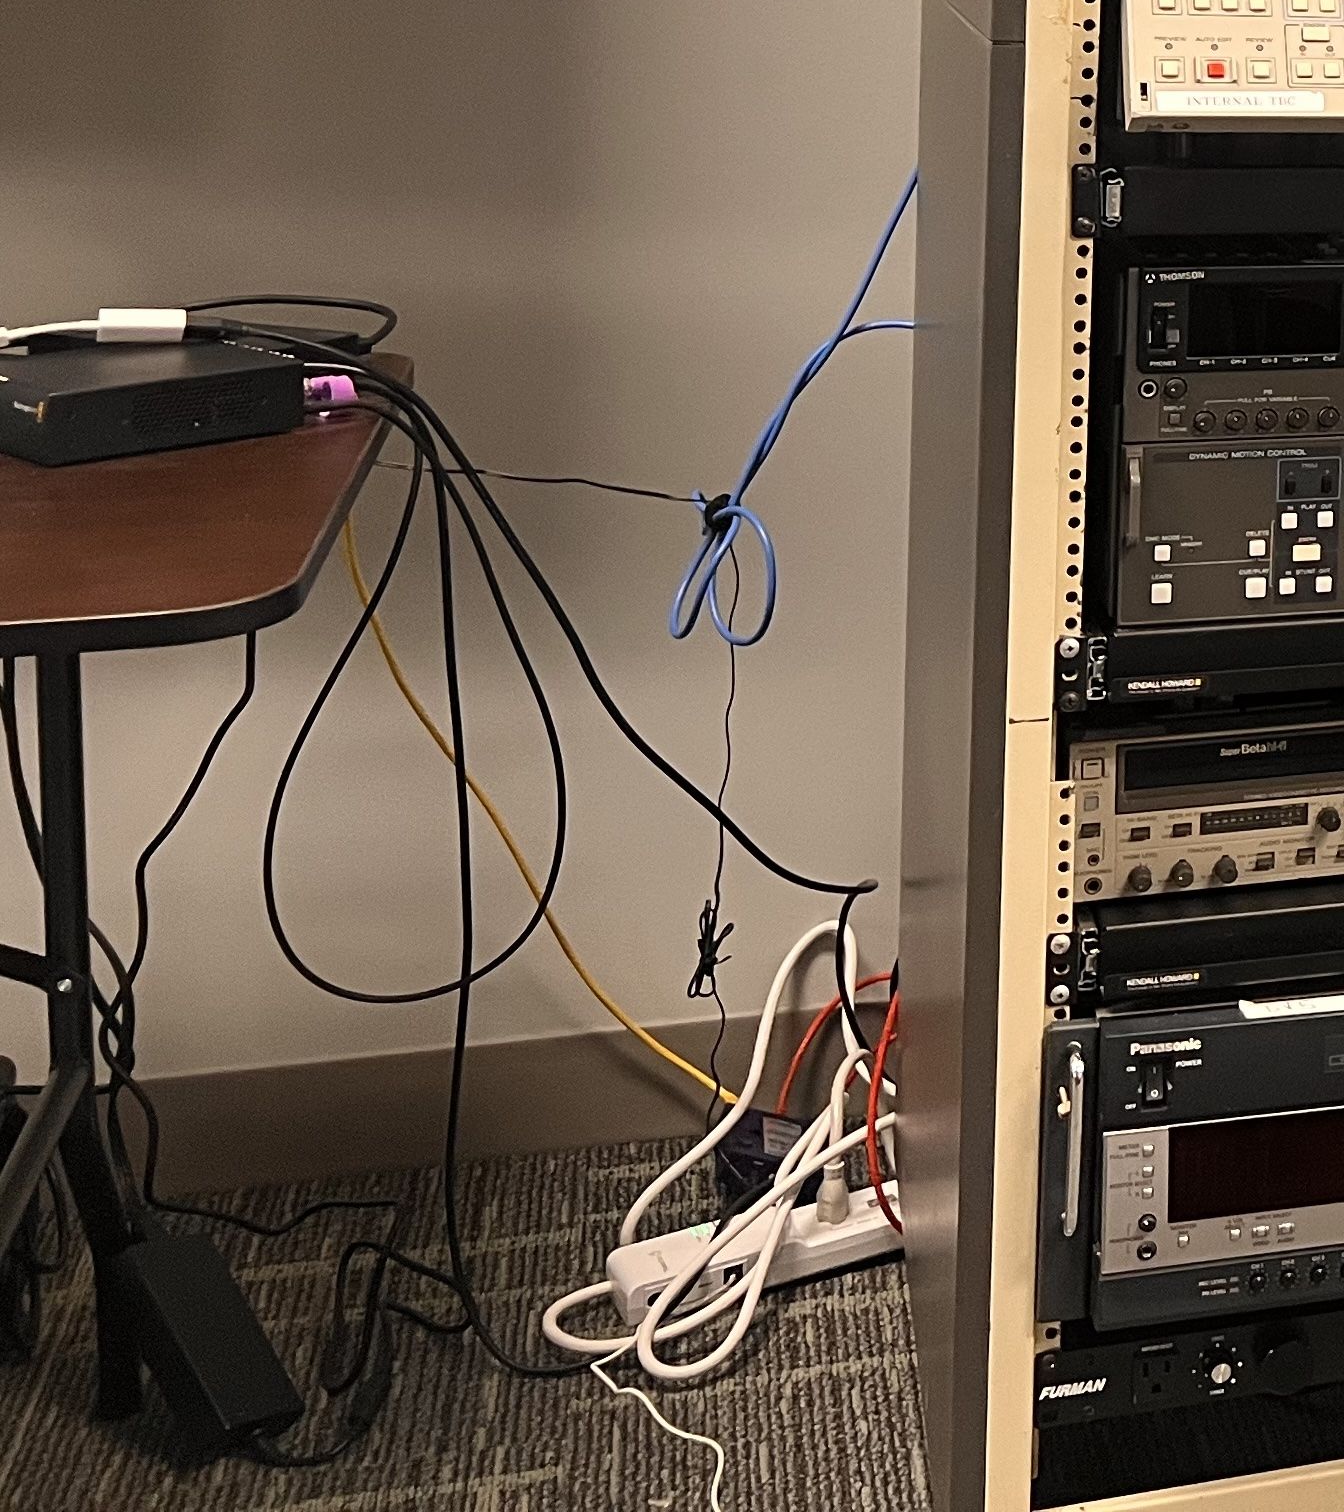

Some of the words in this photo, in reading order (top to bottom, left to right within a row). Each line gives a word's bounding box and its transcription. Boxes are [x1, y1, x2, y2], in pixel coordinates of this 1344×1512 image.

[1186, 95, 1263, 106] INTERNAL
[1270, 96, 1297, 106] TBC
[1159, 271, 1205, 282] THOMSON
[1188, 451, 1229, 461] DYNAMIC
[1231, 450, 1265, 459] MOTION
[1266, 448, 1307, 458] CONTROL
[1128, 680, 1160, 690] KENDALL
[1161, 678, 1194, 688] HOWARD
[1241, 743, 1266, 755] Beta
[1127, 976, 1158, 987] KENDALL
[1130, 1037, 1202, 1056] Panasonic
[1175, 1059, 1202, 1068] POWER
[1039, 1377, 1106, 1401] FURMAN
